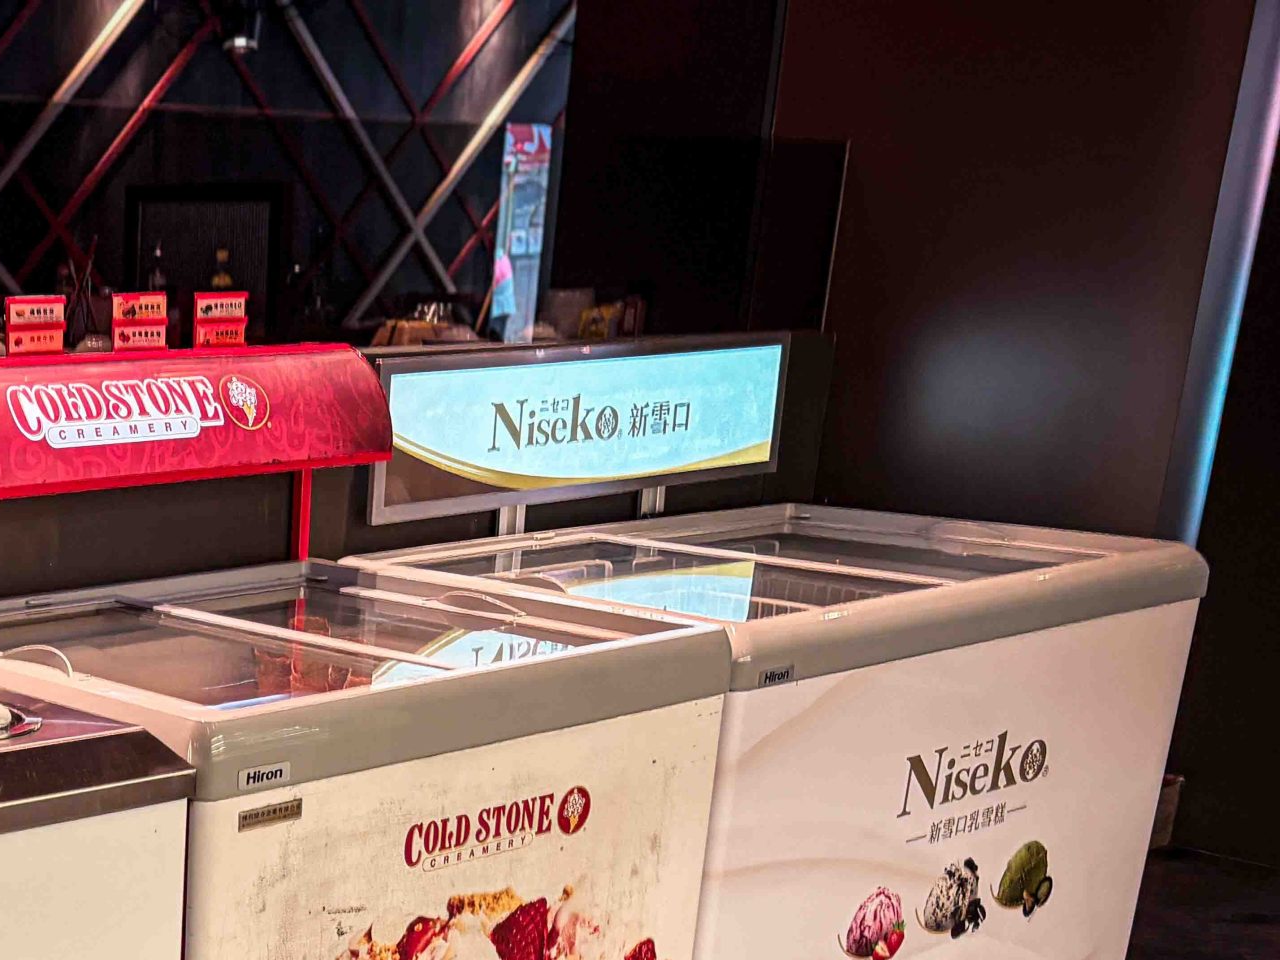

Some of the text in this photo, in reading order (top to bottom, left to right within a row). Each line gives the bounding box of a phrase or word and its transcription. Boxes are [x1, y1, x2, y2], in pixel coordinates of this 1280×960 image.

[8, 376, 221, 440] COLD STONE
[487, 393, 619, 453] Niseko
[58, 420, 190, 441] CREAMERY
[763, 669, 790, 684] Hiron
[960, 739, 994, 759] ニセコ
[245, 766, 283, 786] Hiron
[896, 730, 1047, 818] Niseko
[403, 792, 555, 868] COLD STONE
[429, 834, 527, 869] CREAMERY
